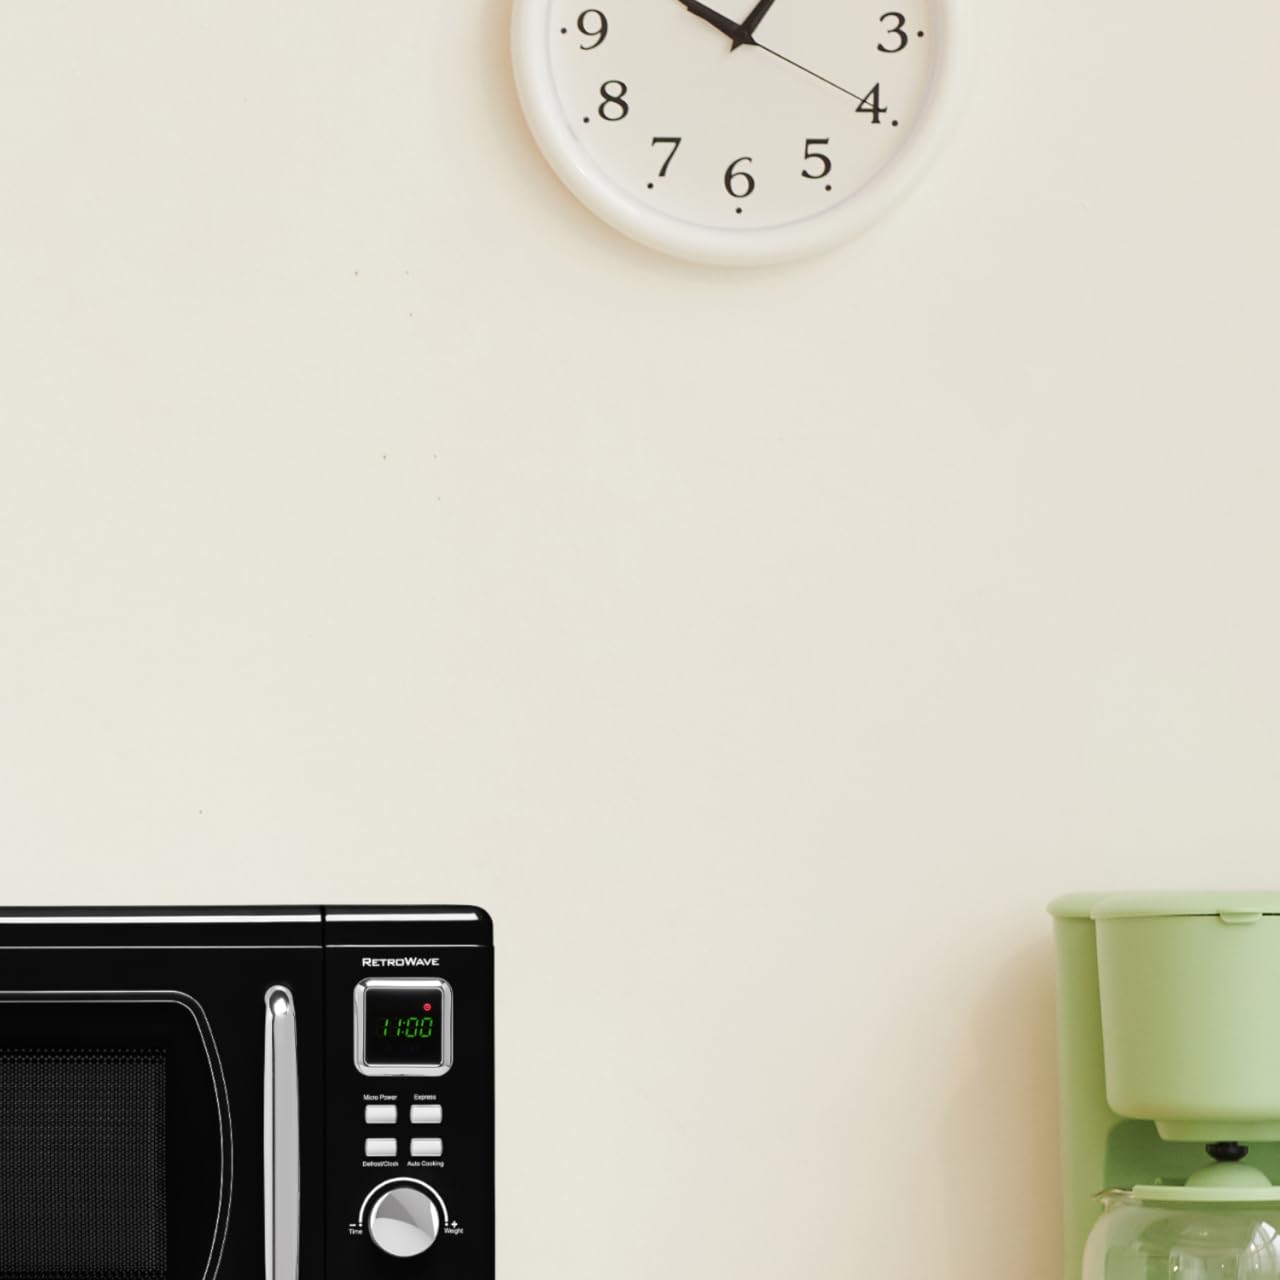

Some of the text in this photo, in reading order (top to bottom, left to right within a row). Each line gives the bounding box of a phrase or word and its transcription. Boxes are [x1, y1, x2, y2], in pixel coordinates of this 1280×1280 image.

[576, 9, 609, 50] 9
[876, 11, 909, 53] 3
[597, 79, 630, 121] 8
[854, 82, 888, 124] 4
[650, 136, 682, 177] 7
[800, 138, 832, 179] 5
[723, 157, 756, 198] 6
[382, 1016, 434, 1038] 11:00
[421, 1160, 445, 1168] Cooking
[444, 1227, 464, 1235] Weight
